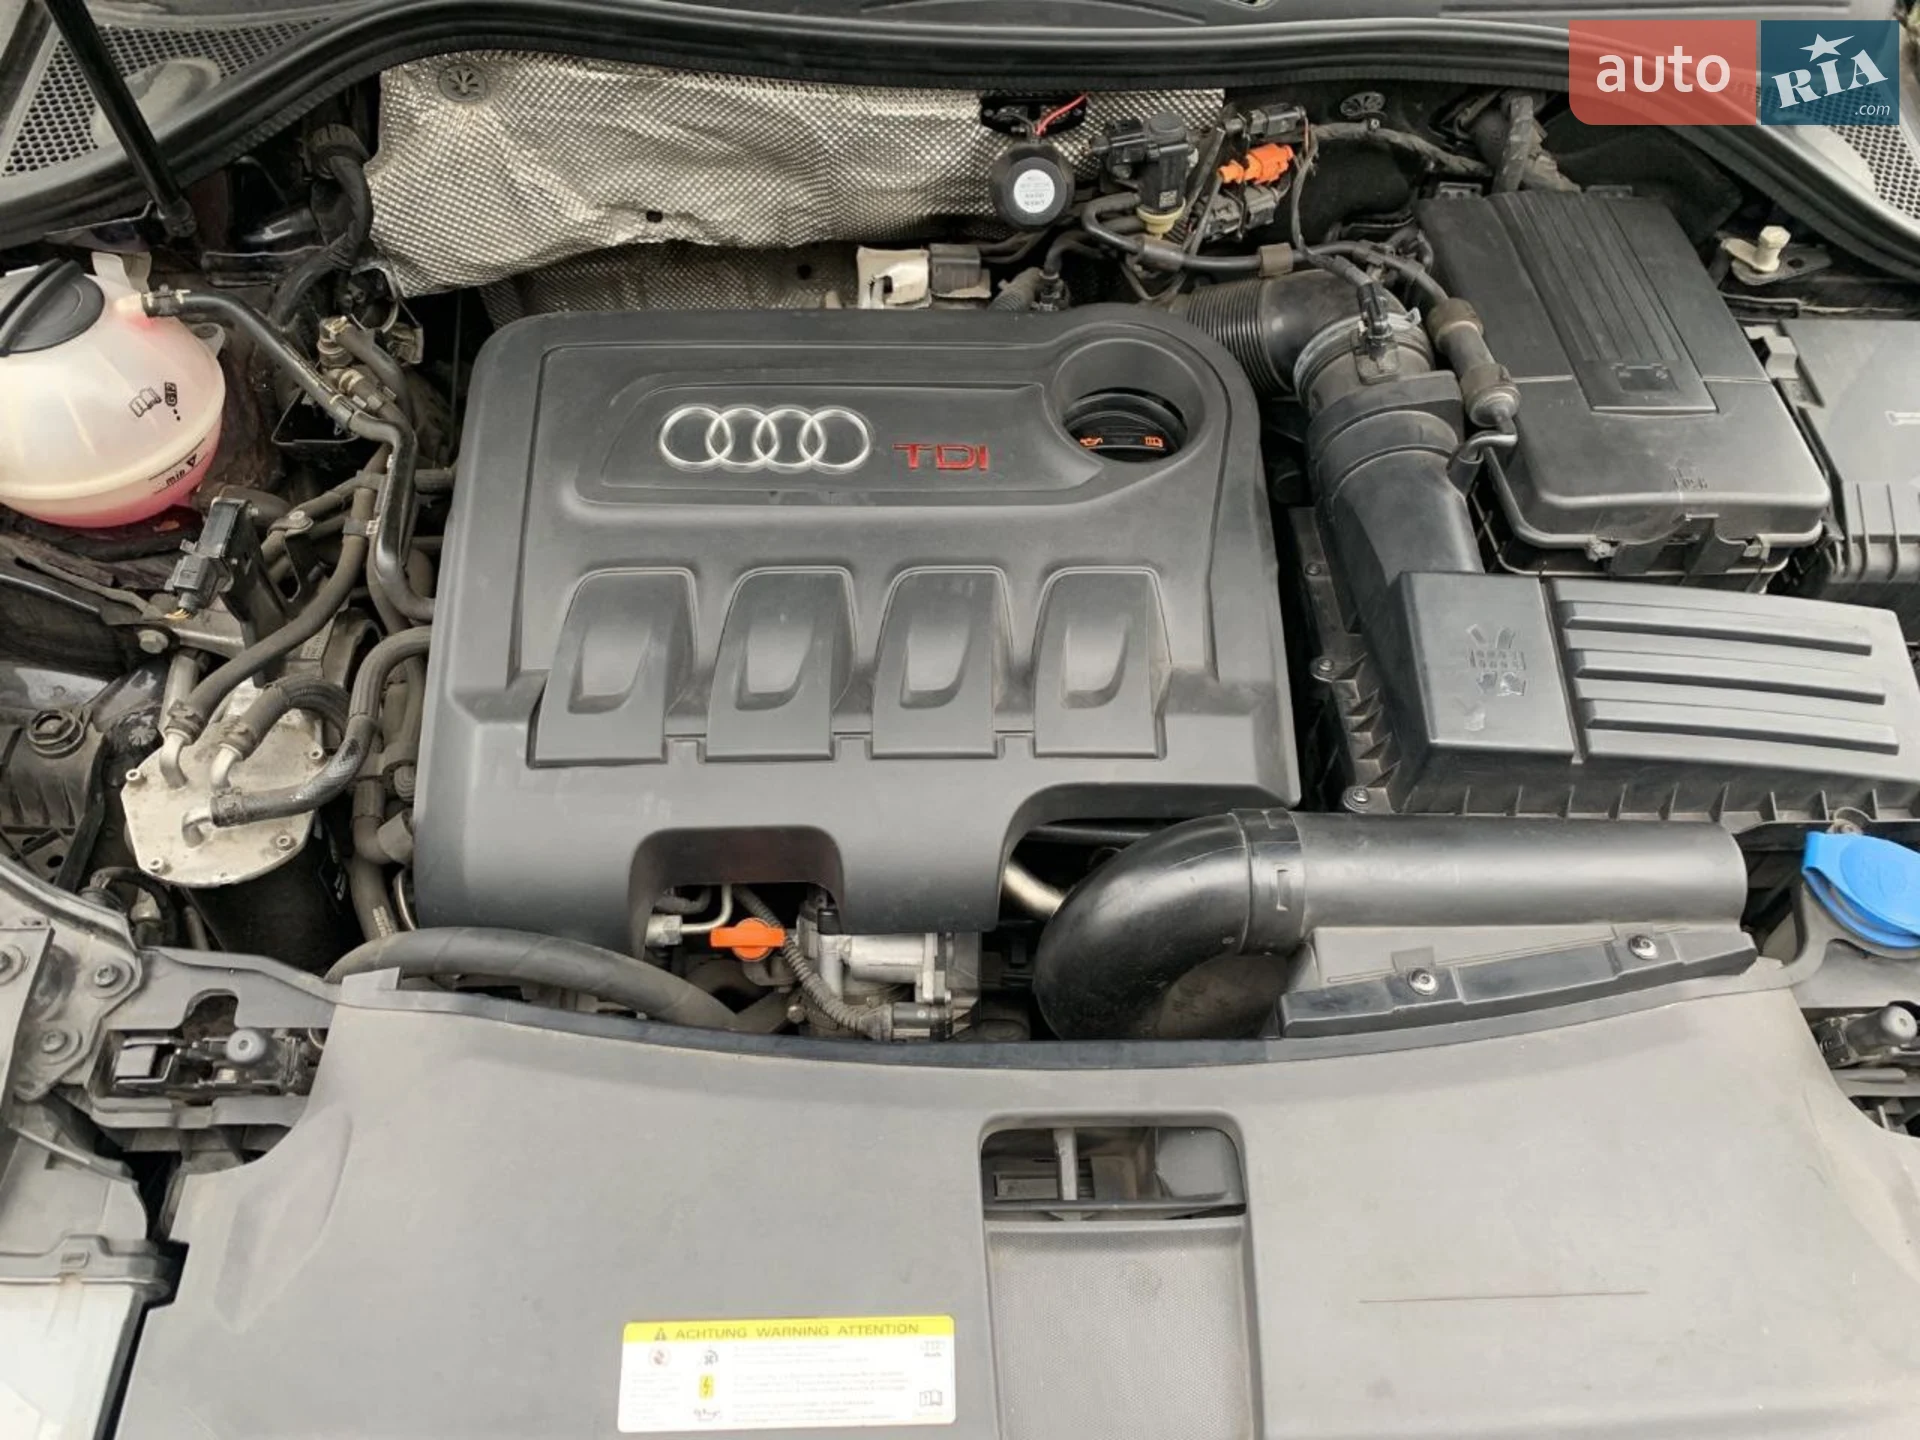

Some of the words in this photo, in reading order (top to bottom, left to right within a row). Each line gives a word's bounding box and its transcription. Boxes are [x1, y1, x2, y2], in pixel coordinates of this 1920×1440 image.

[893, 443, 989, 470] TDI
[675, 1328, 748, 1340] ACHTUNG
[756, 1325, 830, 1338] WARNING
[838, 1323, 919, 1336] ATTENTION
